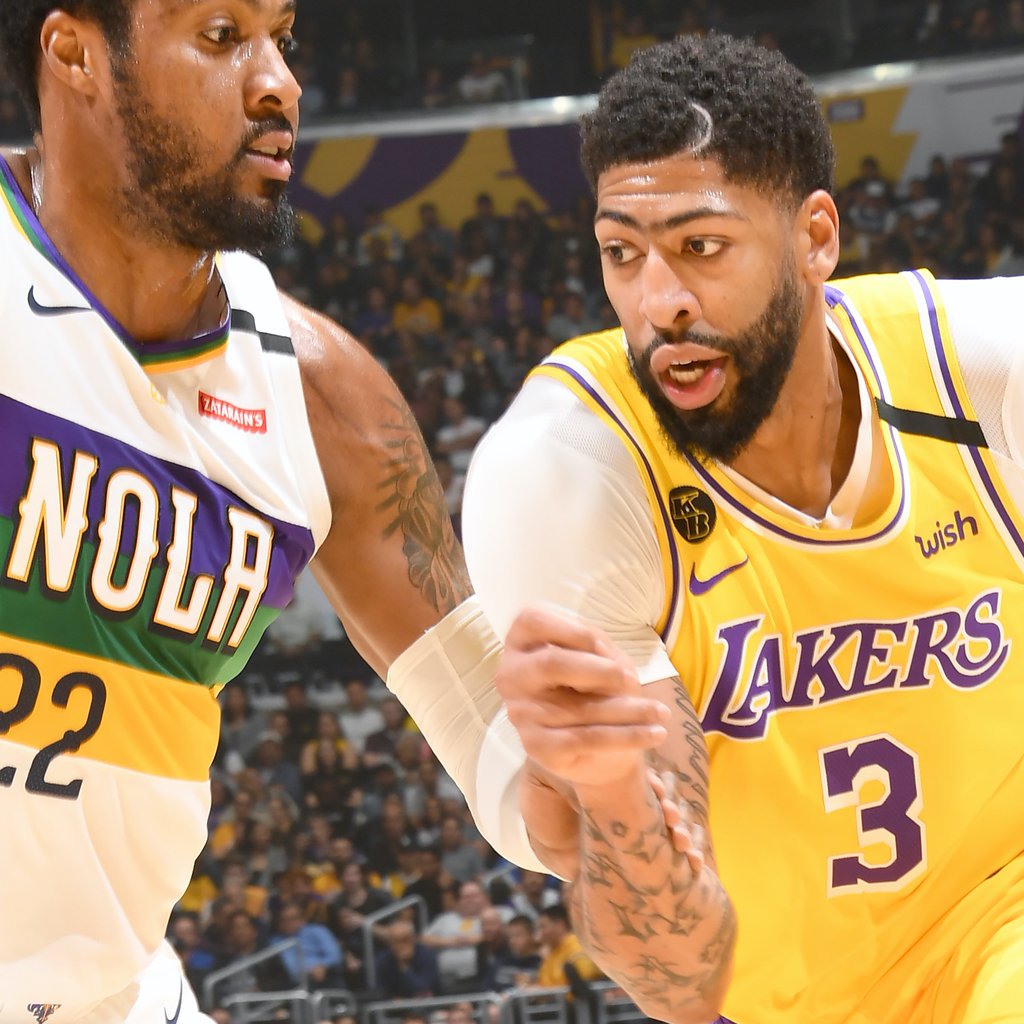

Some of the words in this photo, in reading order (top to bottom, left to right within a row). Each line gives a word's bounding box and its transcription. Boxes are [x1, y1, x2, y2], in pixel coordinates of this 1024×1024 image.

[203, 396, 264, 427] ZATARAIN'S
[5, 437, 276, 652] NOLA
[914, 510, 979, 559] wish
[700, 587, 1013, 740] LAKERS
[818, 732, 929, 899] 3
